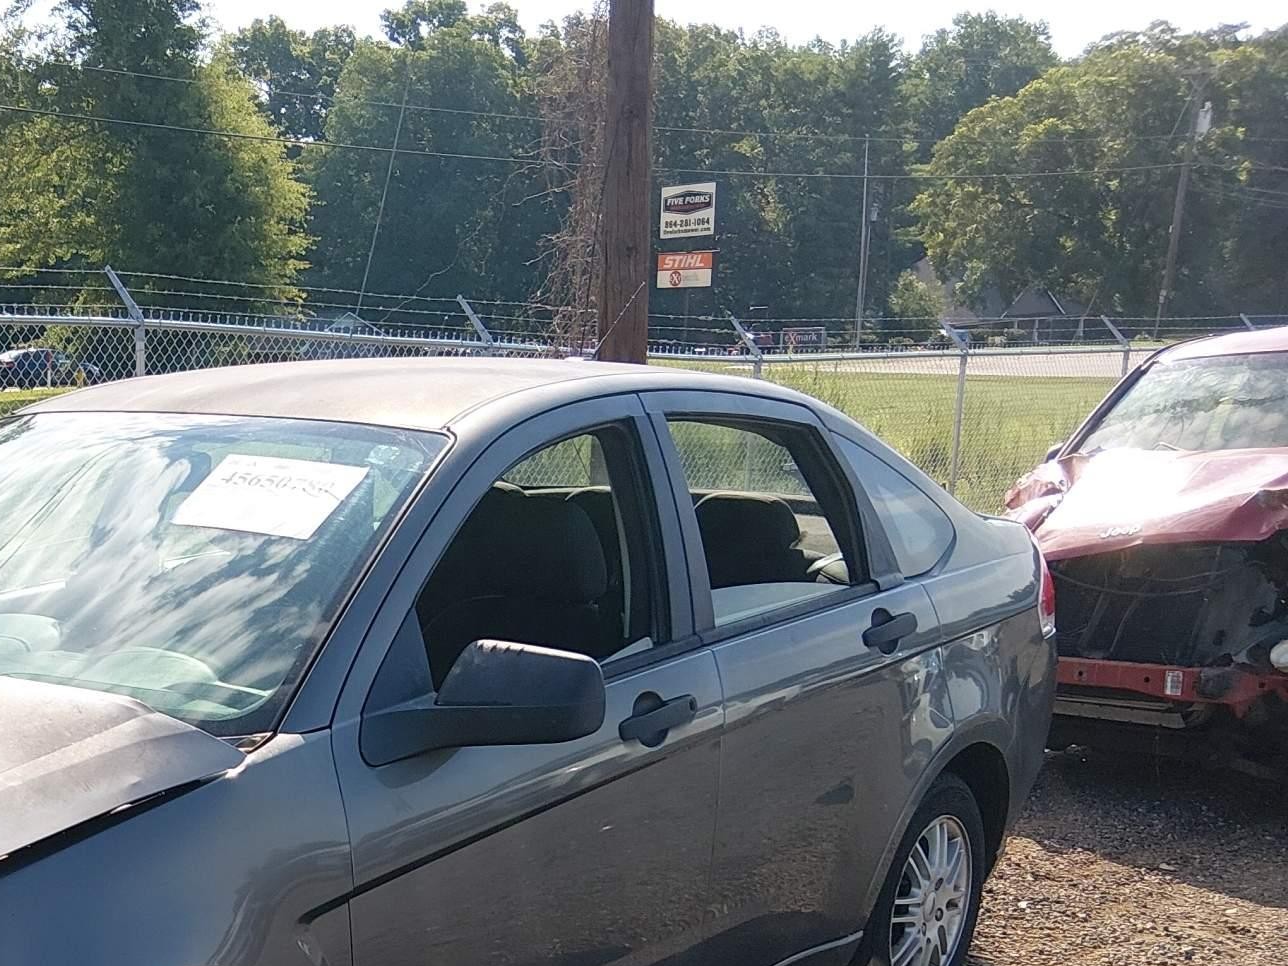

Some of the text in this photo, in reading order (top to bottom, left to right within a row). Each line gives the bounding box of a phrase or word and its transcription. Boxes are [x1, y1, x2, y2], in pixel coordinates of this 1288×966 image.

[667, 197, 684, 206] FIVE
[685, 195, 710, 204] FORKS
[663, 255, 705, 268] STIHL
[1098, 525, 1142, 539] Jeep
